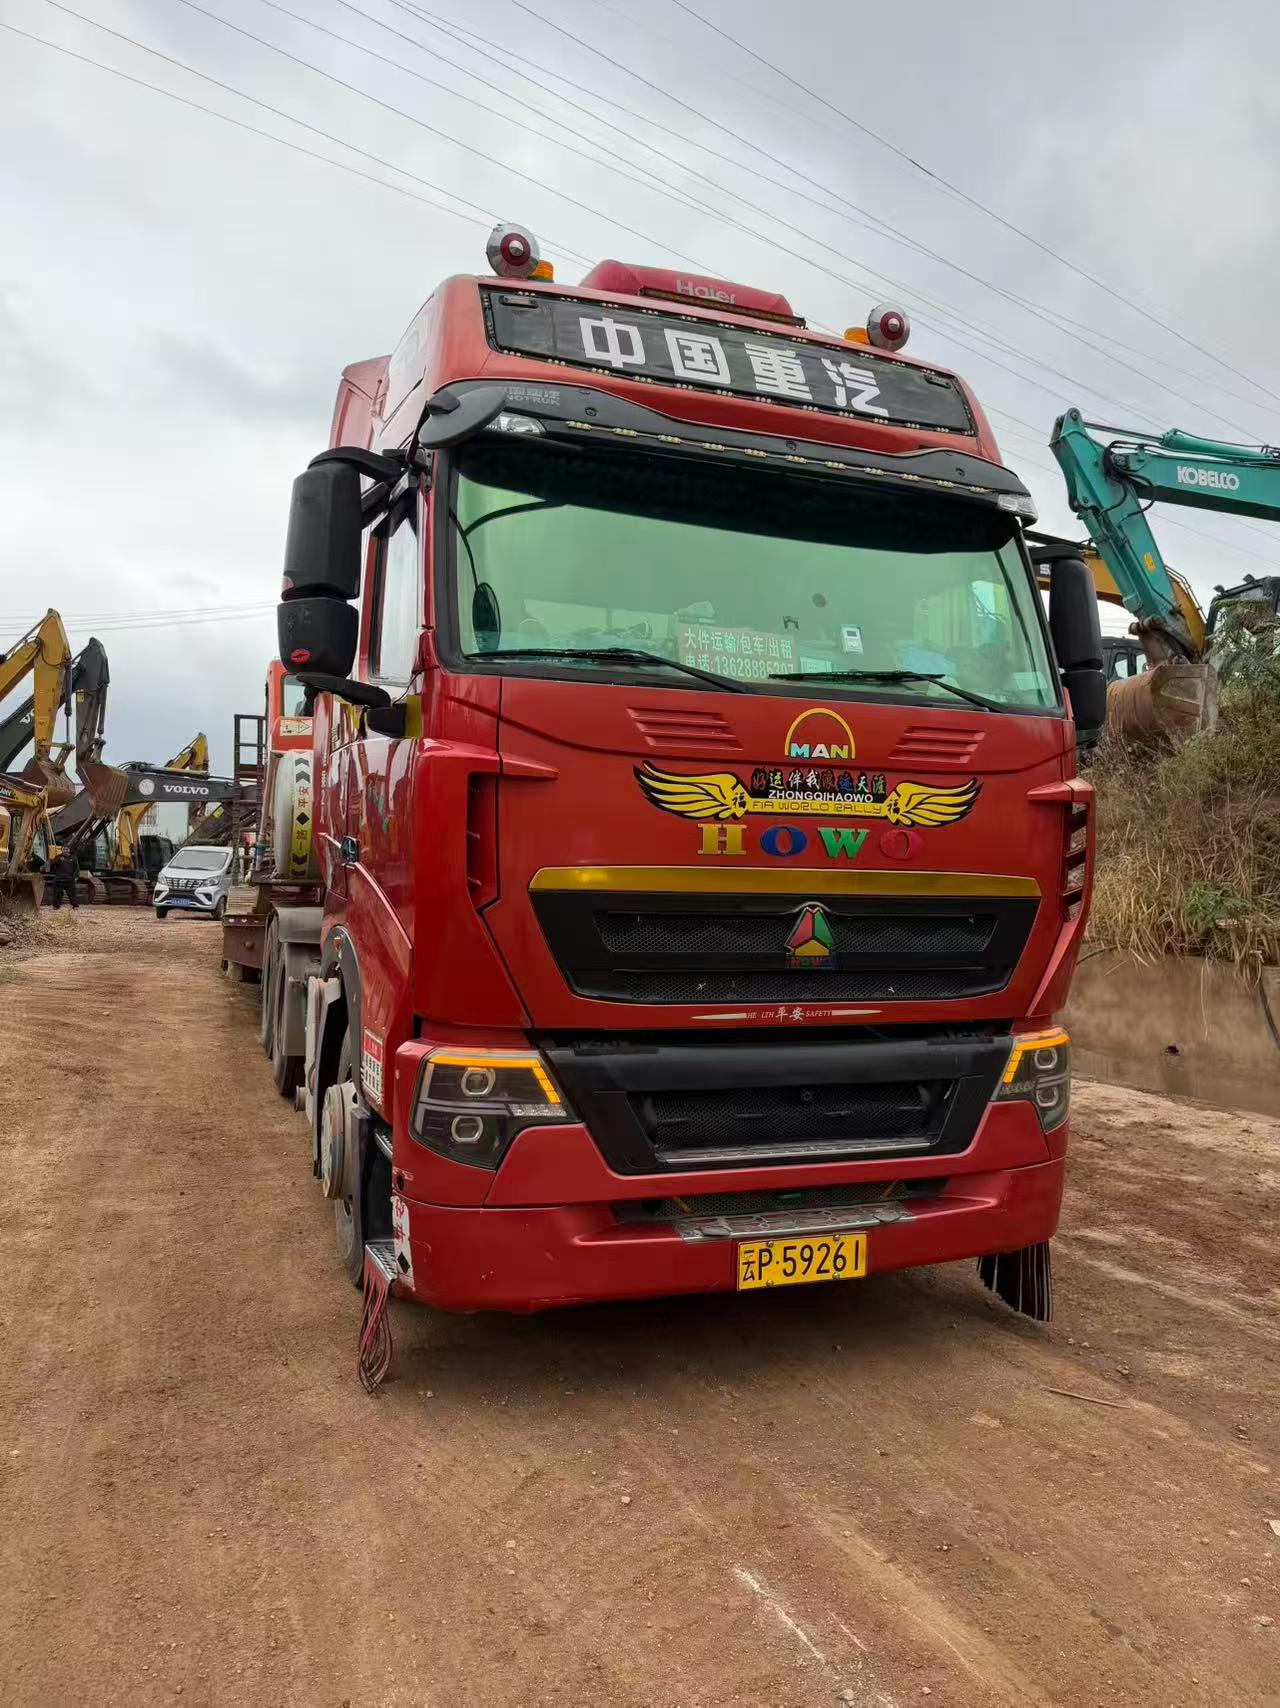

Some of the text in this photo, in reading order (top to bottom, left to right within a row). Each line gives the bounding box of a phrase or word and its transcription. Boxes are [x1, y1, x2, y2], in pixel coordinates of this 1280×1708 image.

[676, 280, 737, 304] Haier
[579, 317, 889, 417] 中国重汽
[1177, 466, 1240, 491] KOBELCO
[790, 742, 850, 760] MAN
[163, 784, 209, 796] VOLVO
[768, 789, 874, 803] ZHONGQIHAOWO
[752, 801, 882, 814] FIA WORLD RALLY
[697, 823, 926, 861] HOWO
[775, 1006, 805, 1022] 平安
[805, 1009, 832, 1018] SAFETY
